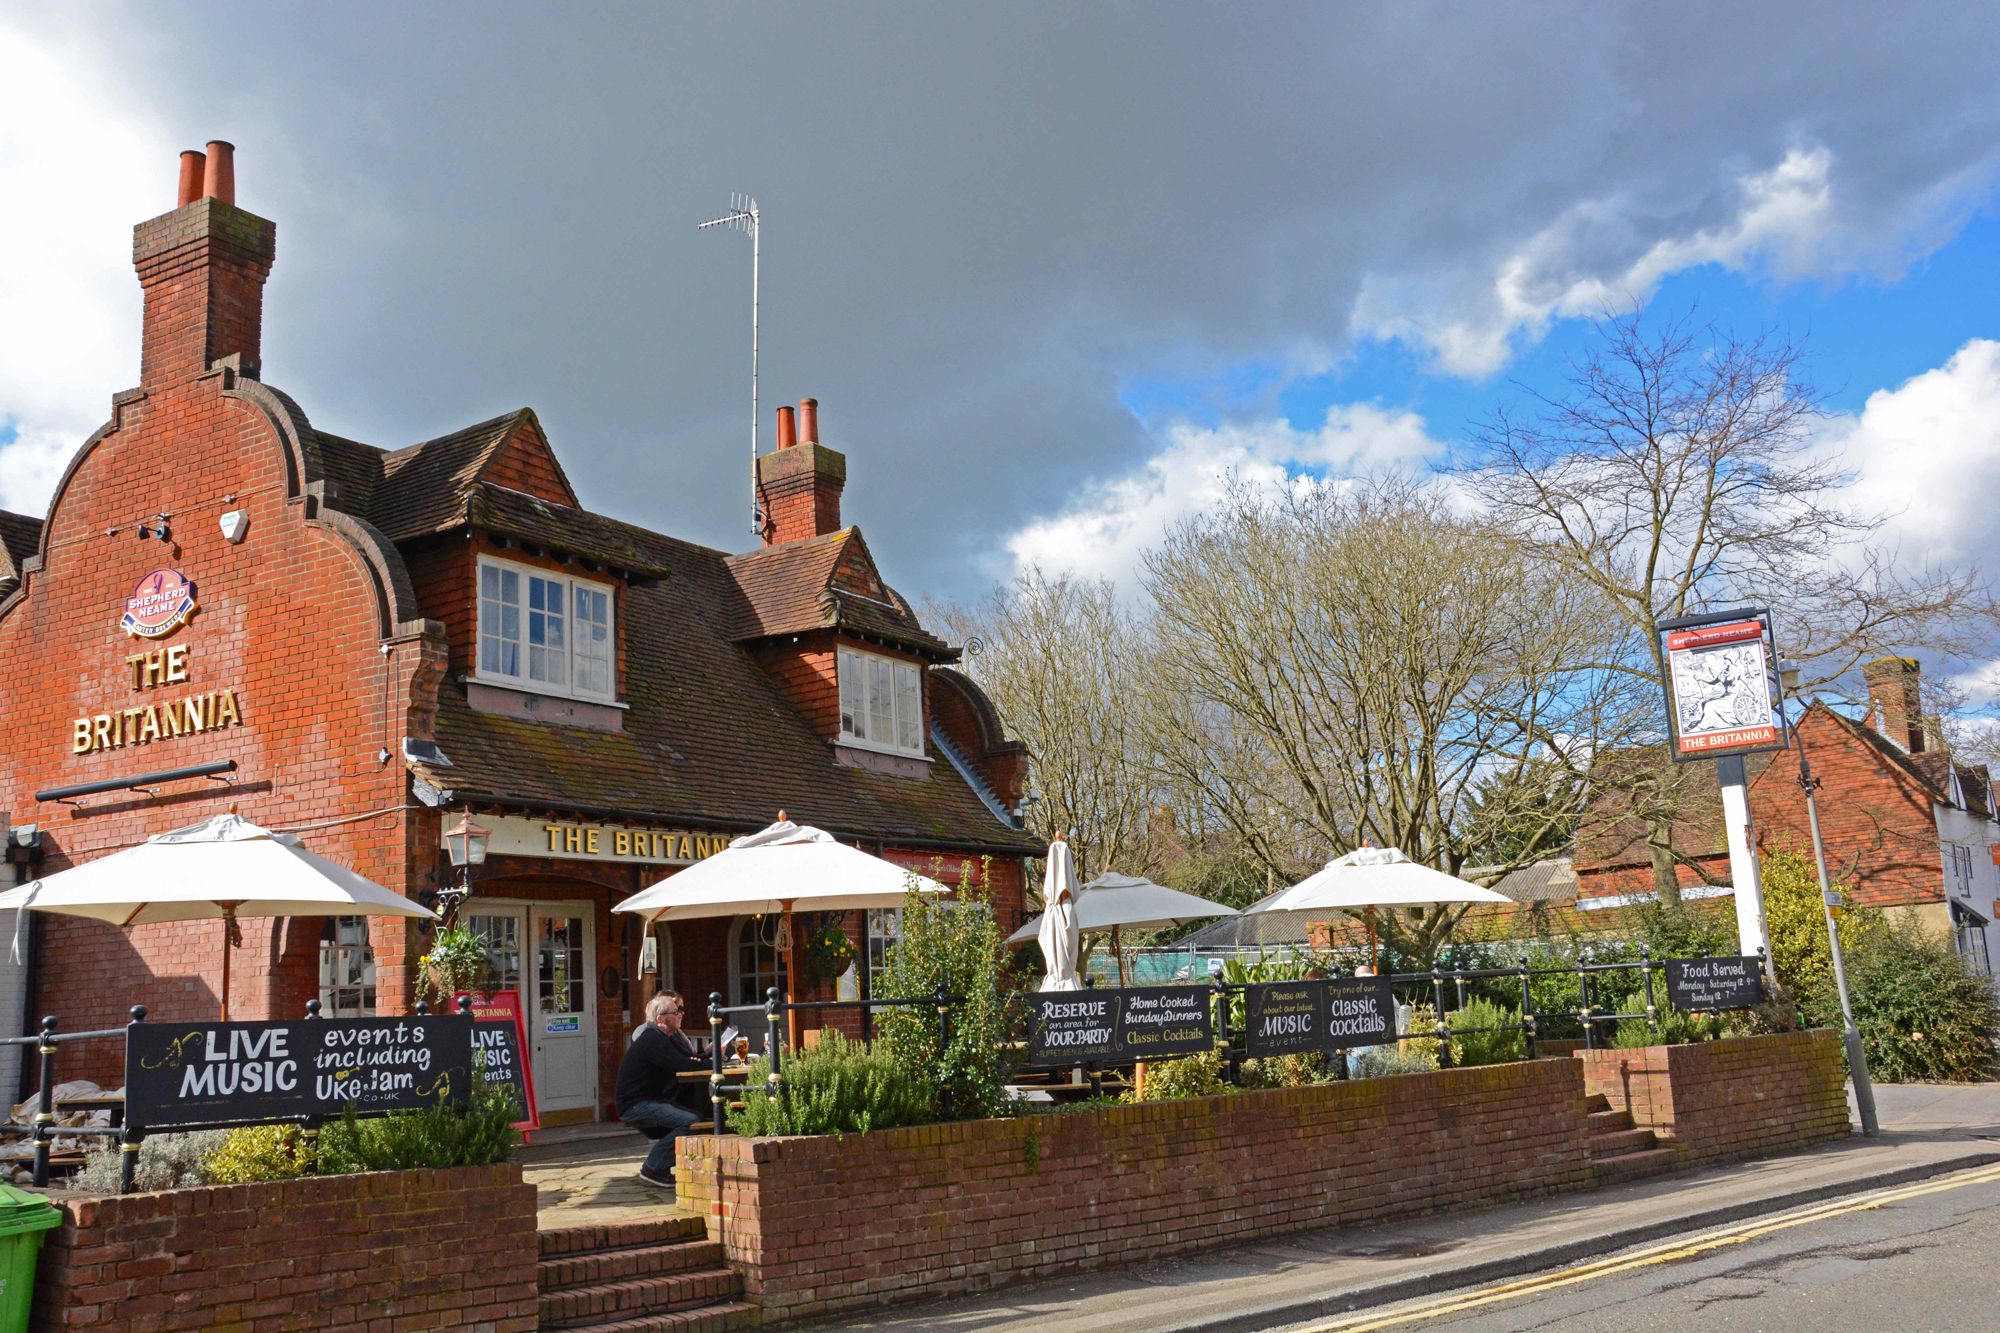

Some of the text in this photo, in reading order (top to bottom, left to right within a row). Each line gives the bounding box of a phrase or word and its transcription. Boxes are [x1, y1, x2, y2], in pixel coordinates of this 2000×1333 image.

[130, 588, 186, 608] SHEPHERD
[139, 602, 175, 618] NEAME
[1672, 628, 1753, 645] SHEPHERD NEAME
[125, 643, 187, 690] THE
[73, 689, 240, 753] BRITANNIA
[1683, 729, 1771, 748] THE BRITANNIA
[545, 825, 726, 860] THE BRITANN
[1681, 961, 1746, 978] Food Served
[1328, 986, 1341, 998] Try
[1342, 986, 1355, 994] one
[1356, 982, 1364, 993] of
[1677, 980, 1705, 994] Monday
[1709, 978, 1737, 992] Saturday
[1130, 994, 1197, 1009] Home Cooked
[1272, 991, 1309, 1001] Please ask
[1691, 992, 1714, 1004] Sunday
[472, 1008, 512, 1018] BRITANNIA
[1041, 1001, 1107, 1019] RESERVE
[1125, 1009, 1202, 1026] Sunday Dinners
[1263, 1004, 1282, 1014] about
[1048, 1022, 1062, 1030] an
[1084, 1017, 1100, 1028] for
[1258, 1014, 1312, 1037] MUSIC
[324, 1022, 425, 1047] events
[470, 1028, 506, 1048] LIVE
[1044, 1028, 1112, 1047] YOUR PARTY
[1127, 1028, 1203, 1044] Classic Cocktails
[1269, 1036, 1302, 1048] event
[205, 1028, 289, 1061] LIVE
[314, 1046, 431, 1071] including
[178, 1060, 297, 1098] MUSIC
[484, 1068, 512, 1081] ents
